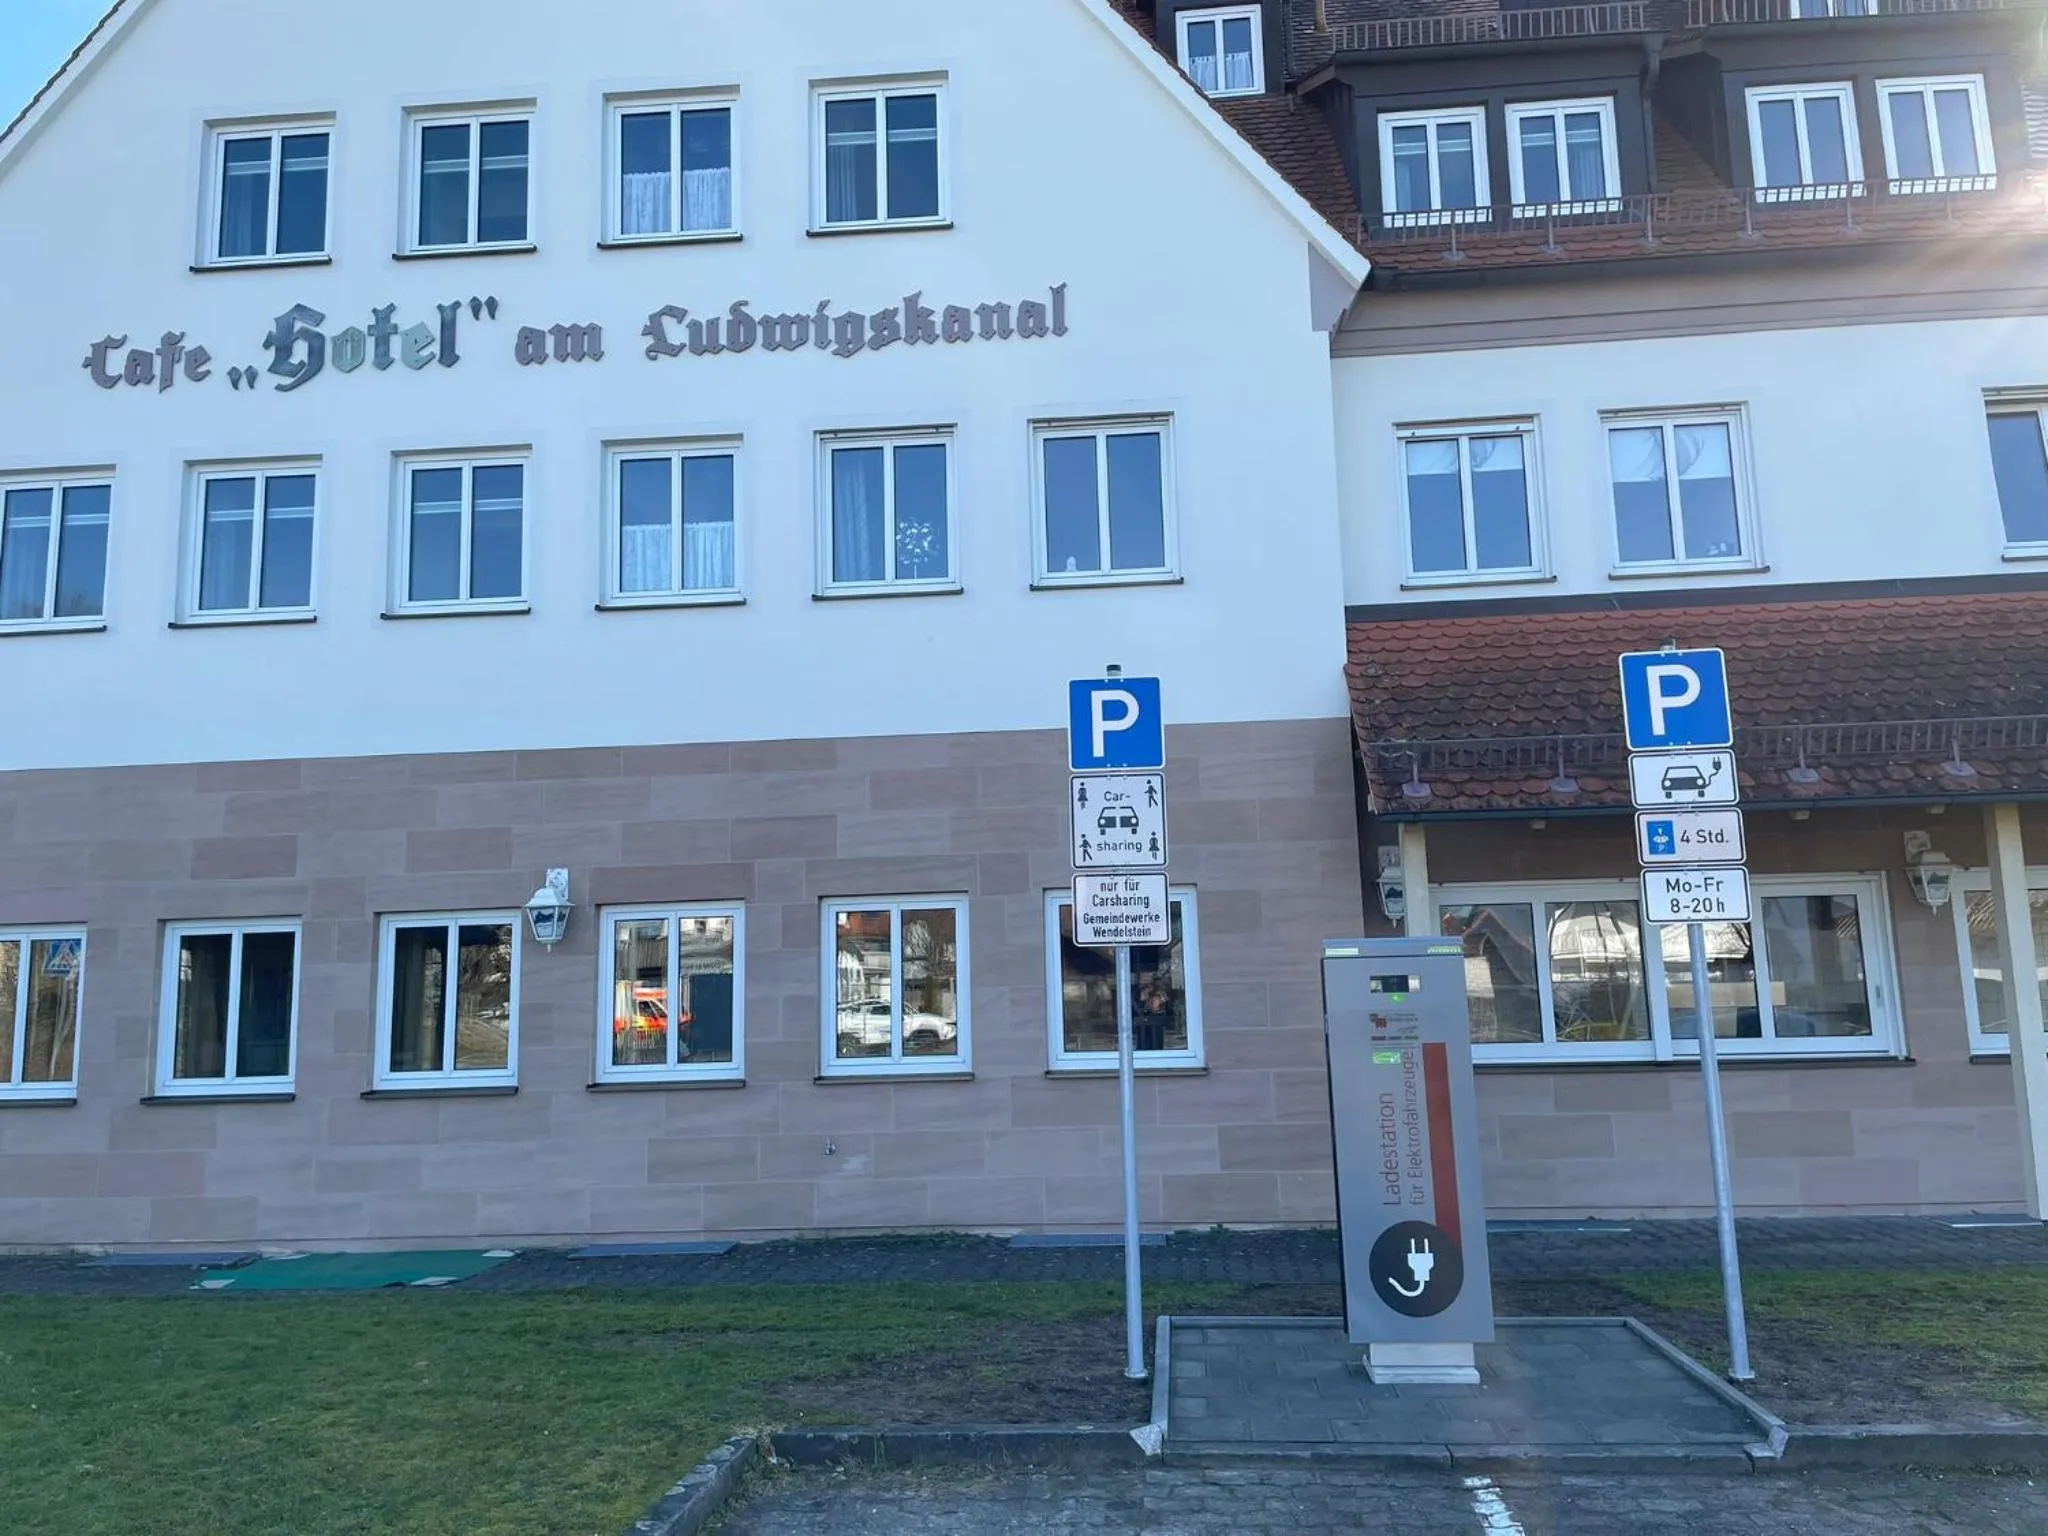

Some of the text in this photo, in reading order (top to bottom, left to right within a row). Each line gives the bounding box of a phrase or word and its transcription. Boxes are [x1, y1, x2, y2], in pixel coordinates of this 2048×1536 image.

[82, 331, 213, 394] Cafe
[515, 322, 604, 366] am
[641, 282, 1069, 361] Ludwigskanal
[1646, 664, 1701, 737] P
[1091, 690, 1140, 758] P
[1103, 791, 1131, 803] Car-
[1680, 829, 1730, 844] 4 Std.
[1097, 840, 1143, 853] sharing
[1100, 878, 1141, 892] nur für
[1666, 877, 1724, 894] Mo-Fr
[1092, 894, 1150, 909] Carsharing
[1083, 912, 1161, 925] Gemeindewerke
[1092, 925, 1152, 938] Wendelstein
[1400, 1048, 1424, 1180] Elektrofahrzeuge
[1377, 1092, 1401, 1207] Ladestation
[1408, 1185, 1425, 1206] für
